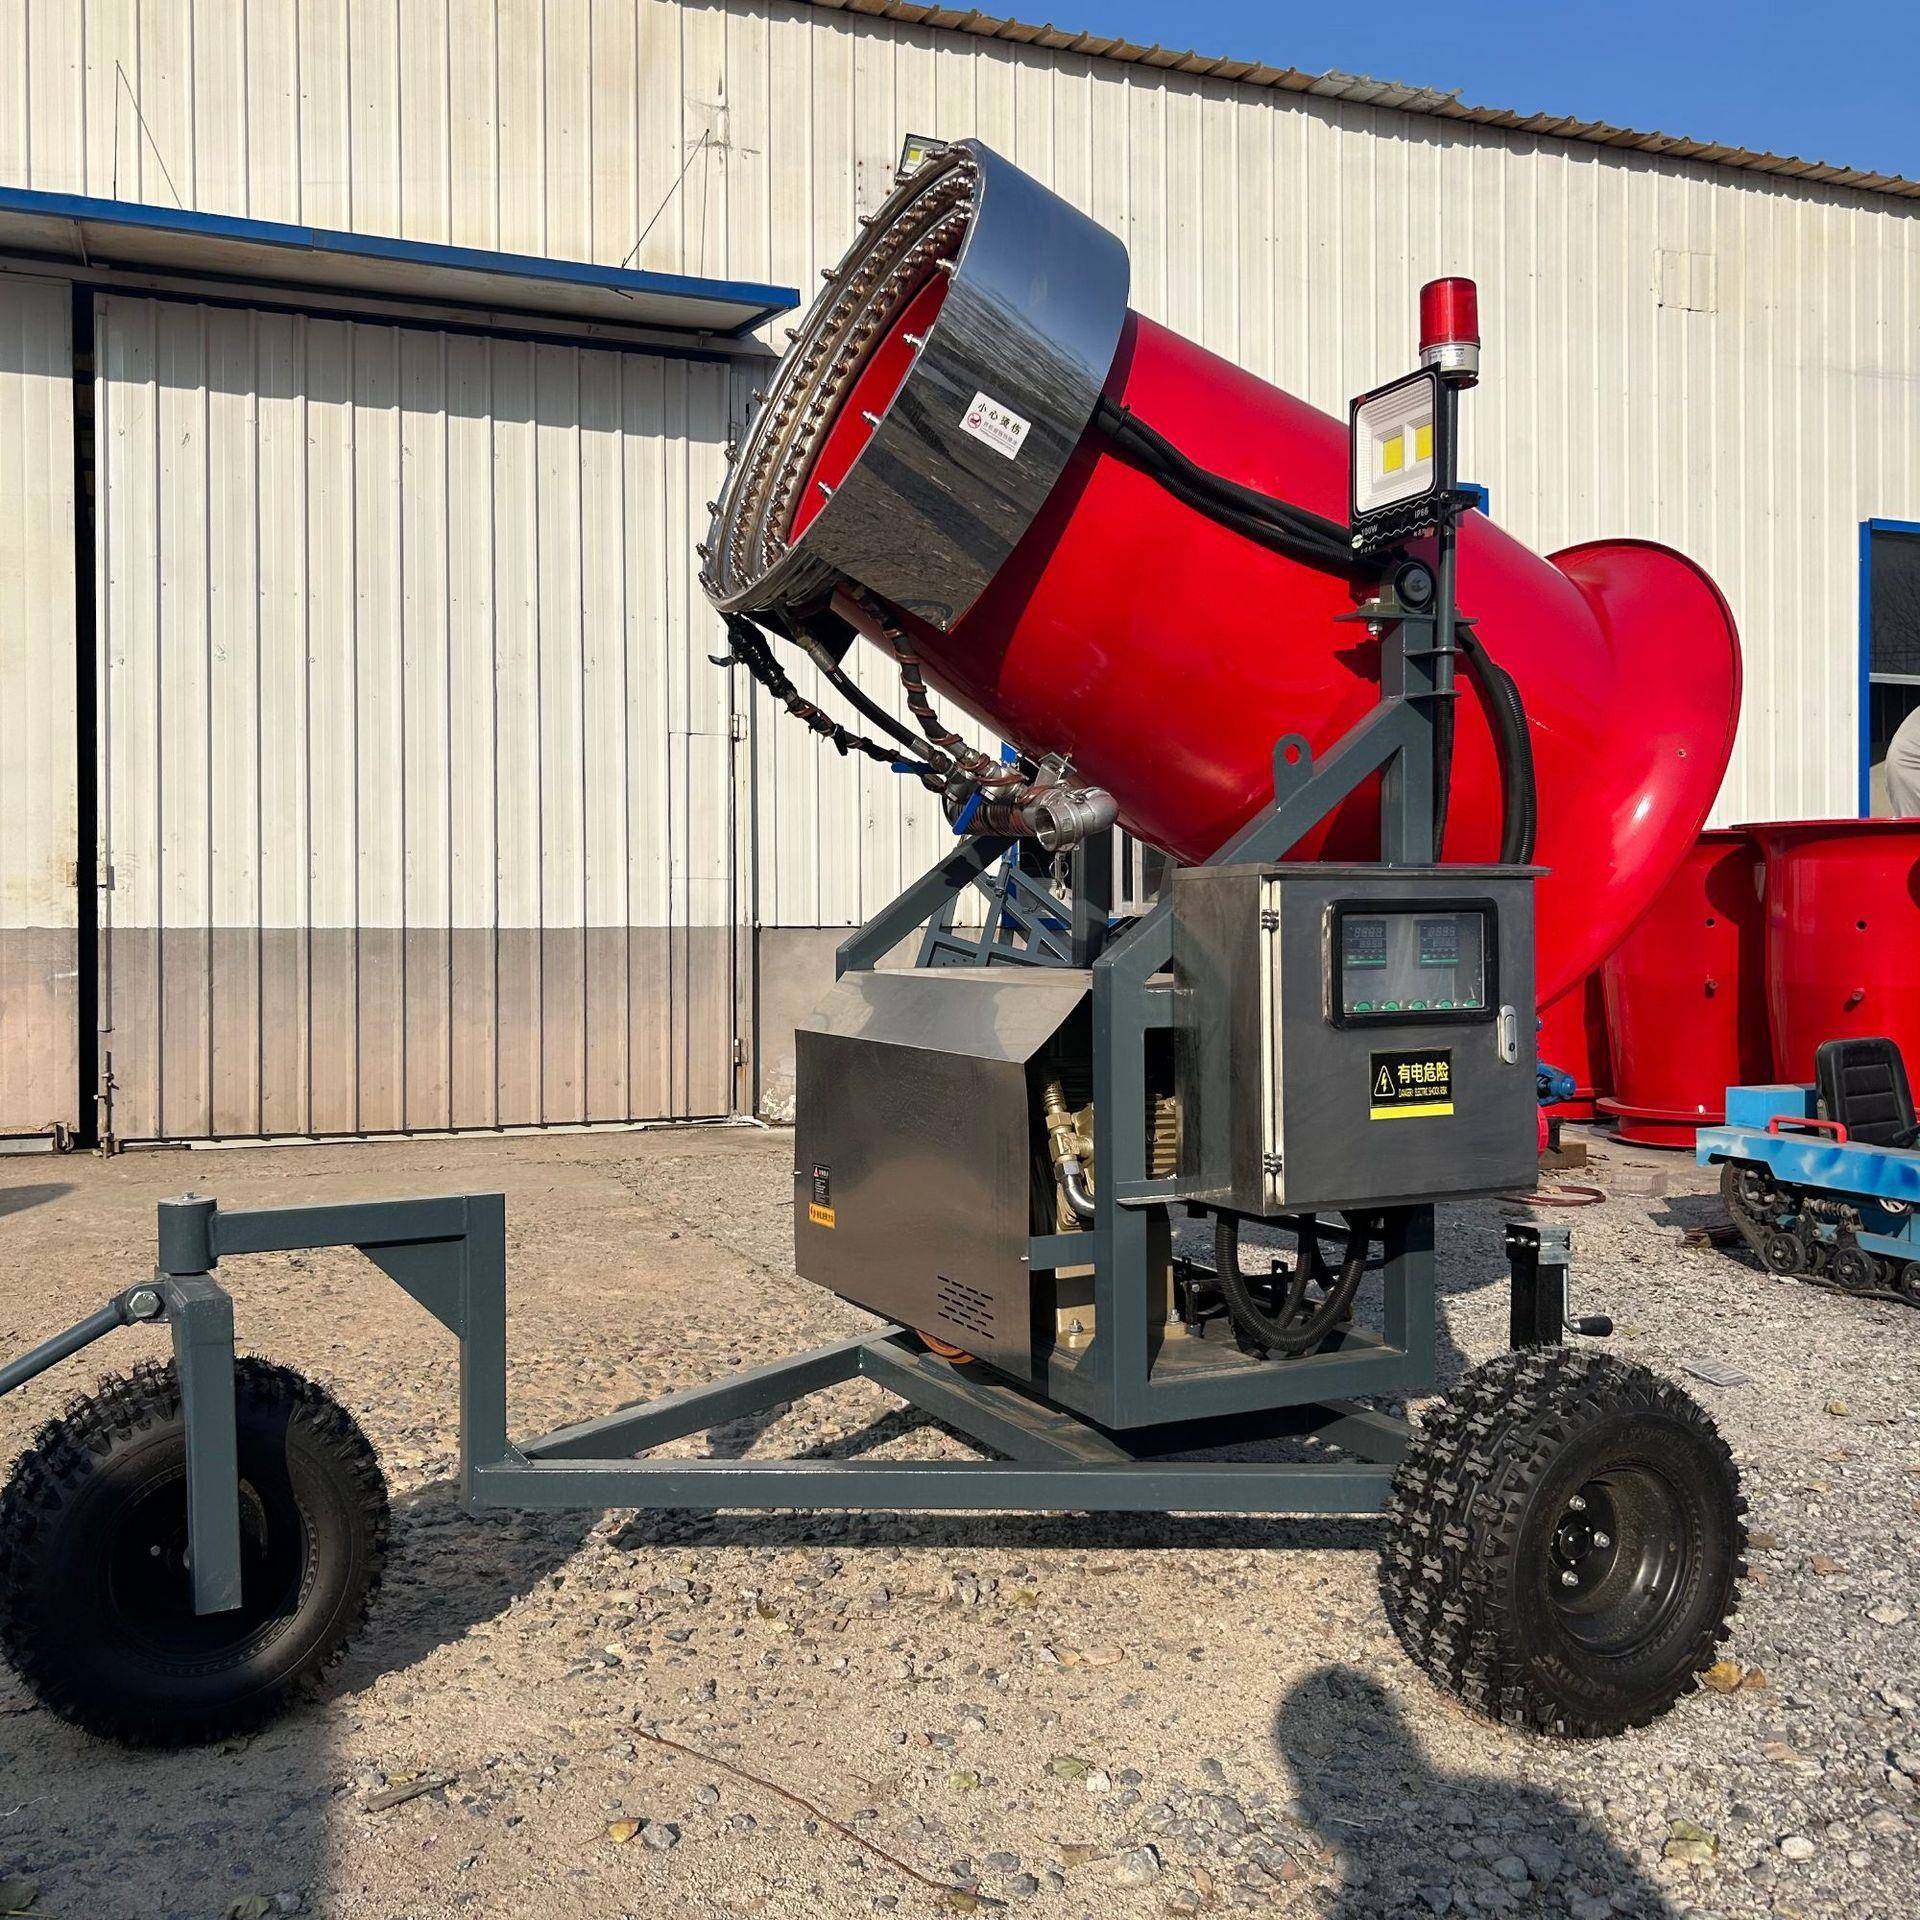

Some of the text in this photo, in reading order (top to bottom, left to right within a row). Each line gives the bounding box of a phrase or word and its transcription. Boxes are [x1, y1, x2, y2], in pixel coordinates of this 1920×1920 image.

[978, 403, 1022, 435] 小心烫伤
[1397, 1061, 1449, 1084] 有电危险
